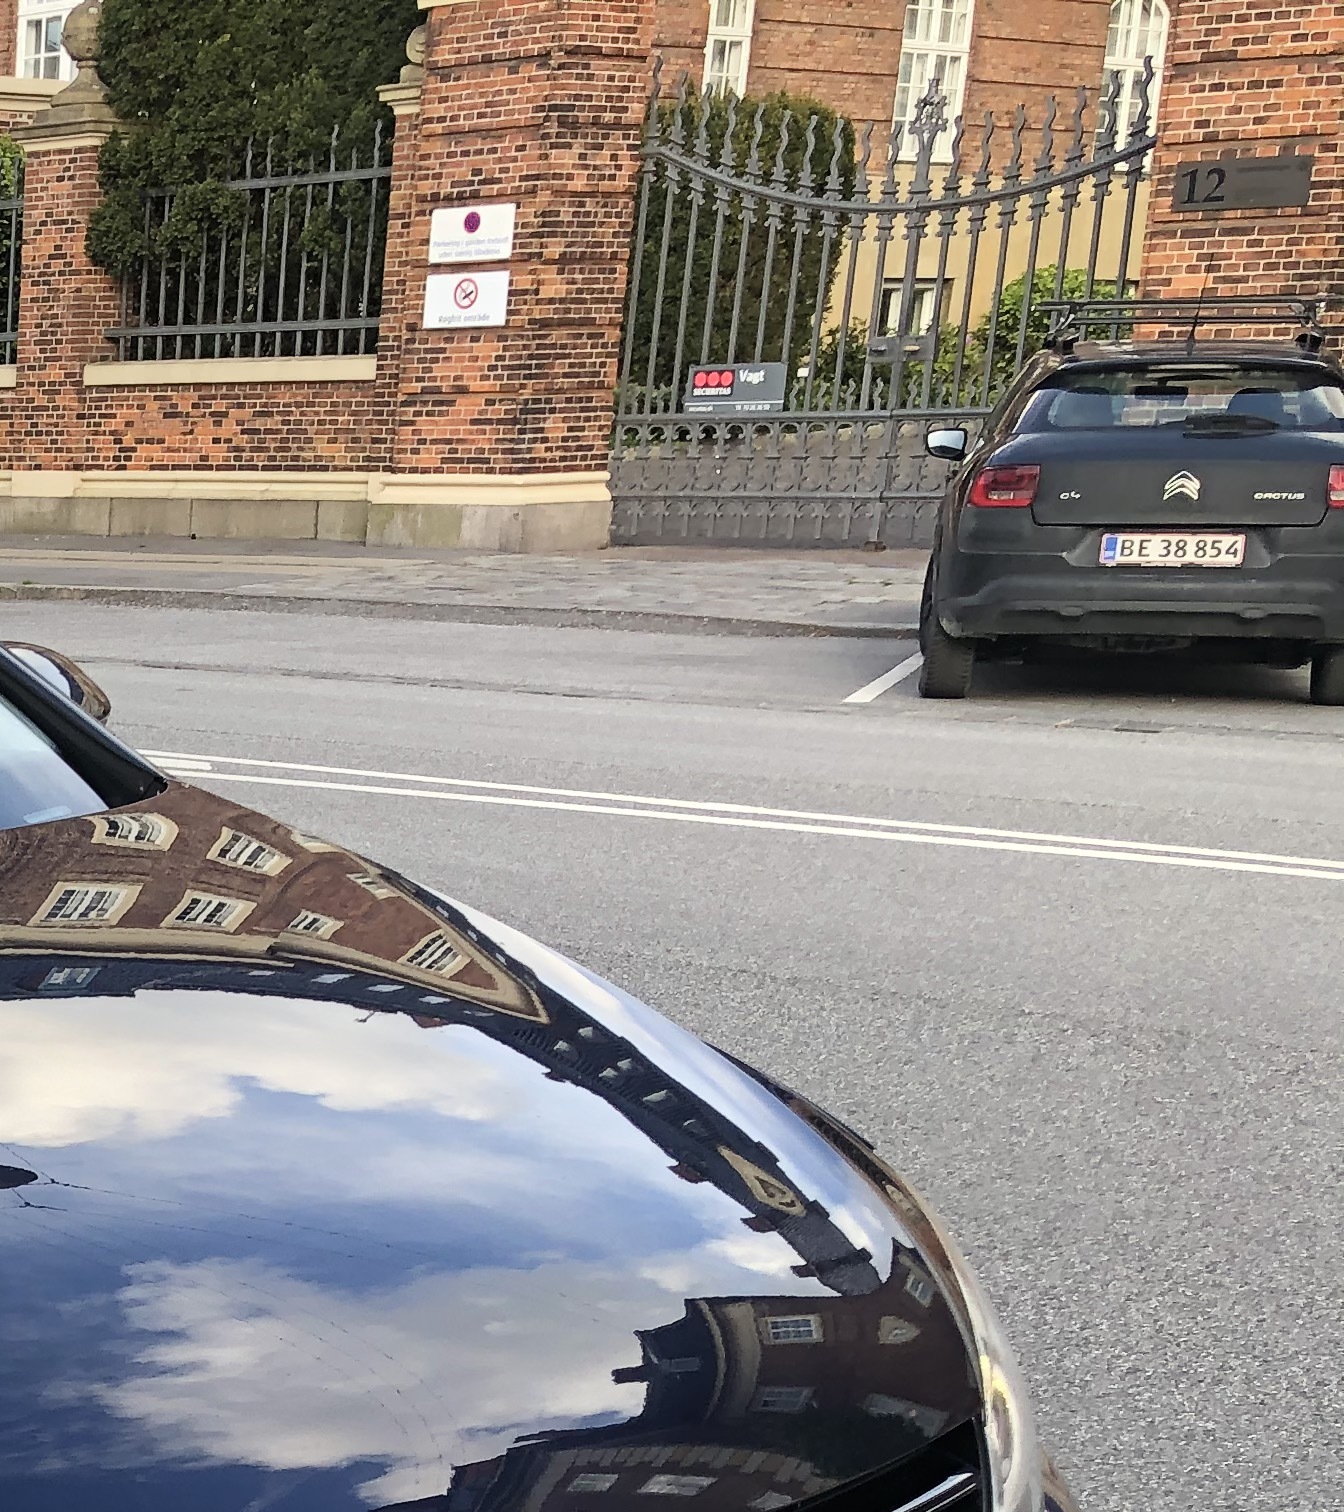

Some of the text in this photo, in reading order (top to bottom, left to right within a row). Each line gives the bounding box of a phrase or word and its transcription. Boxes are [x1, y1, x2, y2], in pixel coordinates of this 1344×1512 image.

[1180, 167, 1227, 204] 12
[739, 369, 765, 384] Vagt
[1253, 491, 1305, 501] CACTUS
[1119, 539, 1151, 557] BE
[1158, 539, 1188, 558] 38
[1193, 540, 1240, 559] 854
